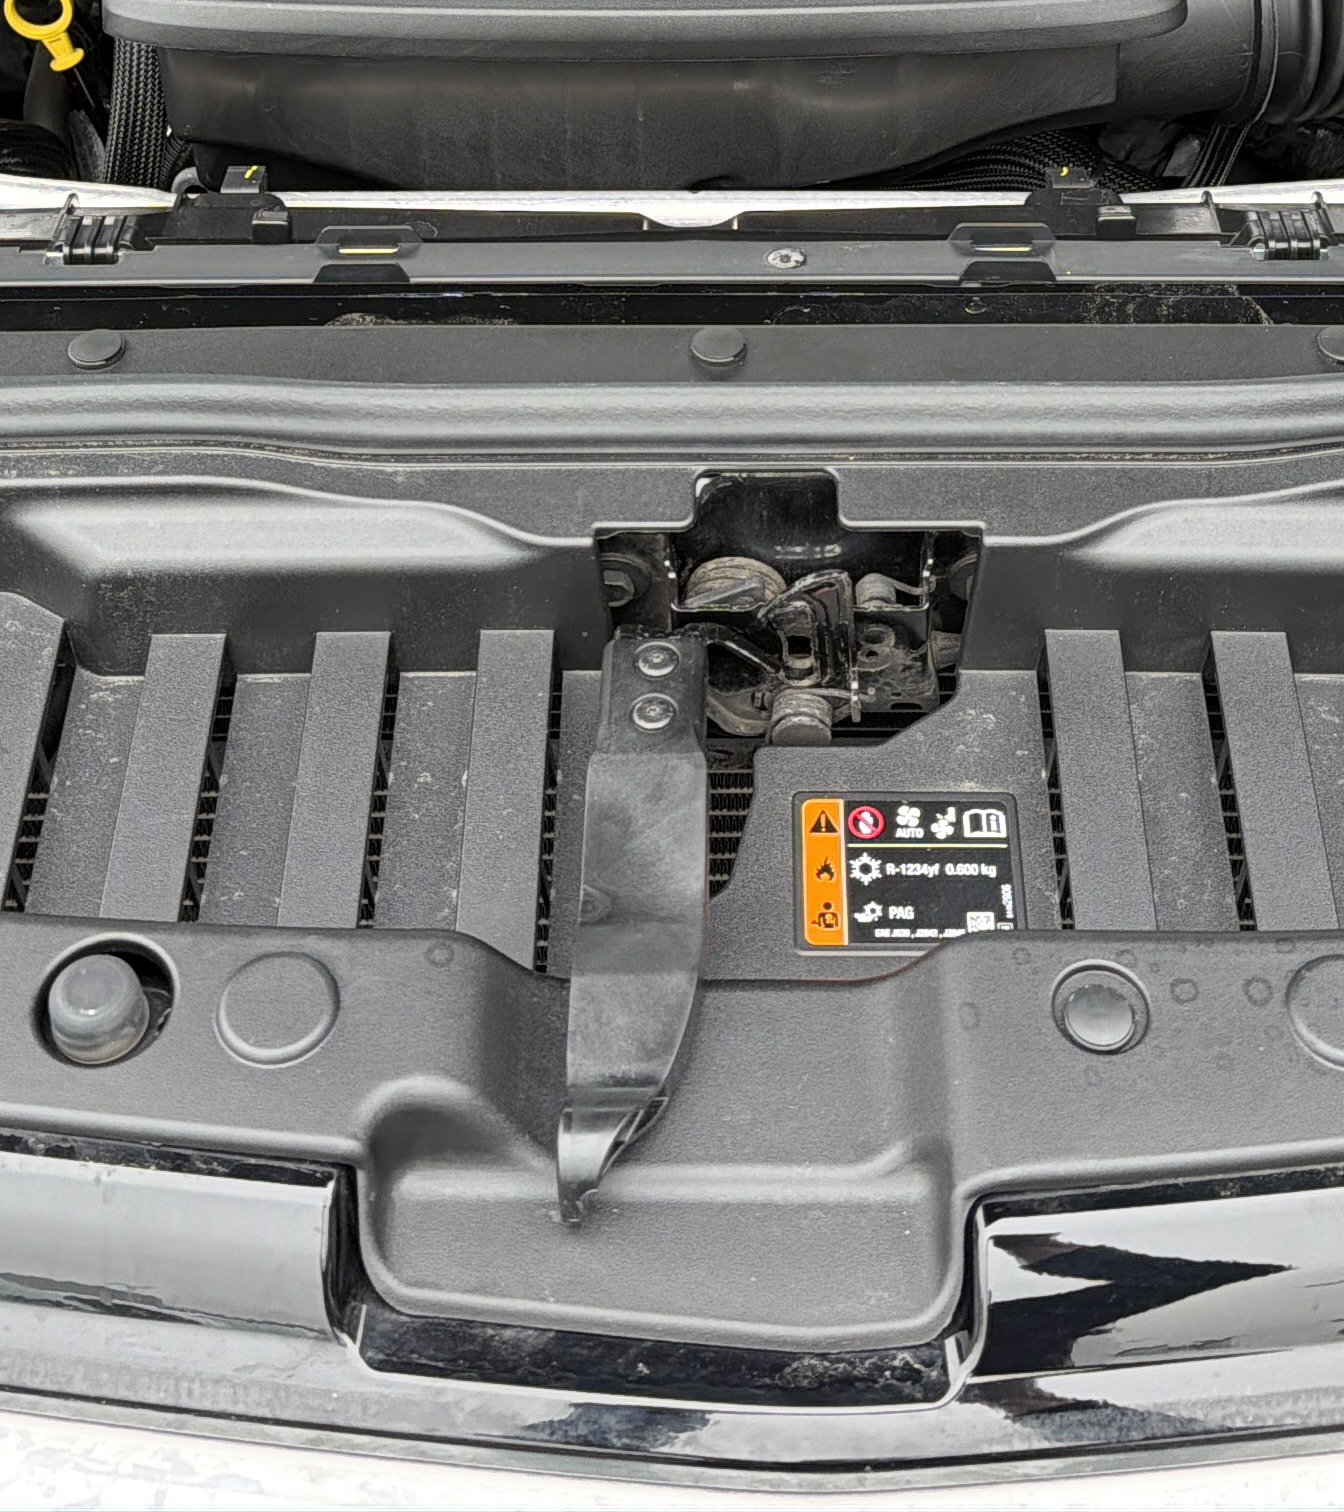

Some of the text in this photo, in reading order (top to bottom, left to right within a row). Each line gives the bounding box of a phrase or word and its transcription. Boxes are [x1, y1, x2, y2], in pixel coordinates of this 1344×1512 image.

[895, 827, 925, 839] AUTO
[886, 863, 997, 878] R-1234yf 0.600 kg
[888, 905, 915, 920] PAG
